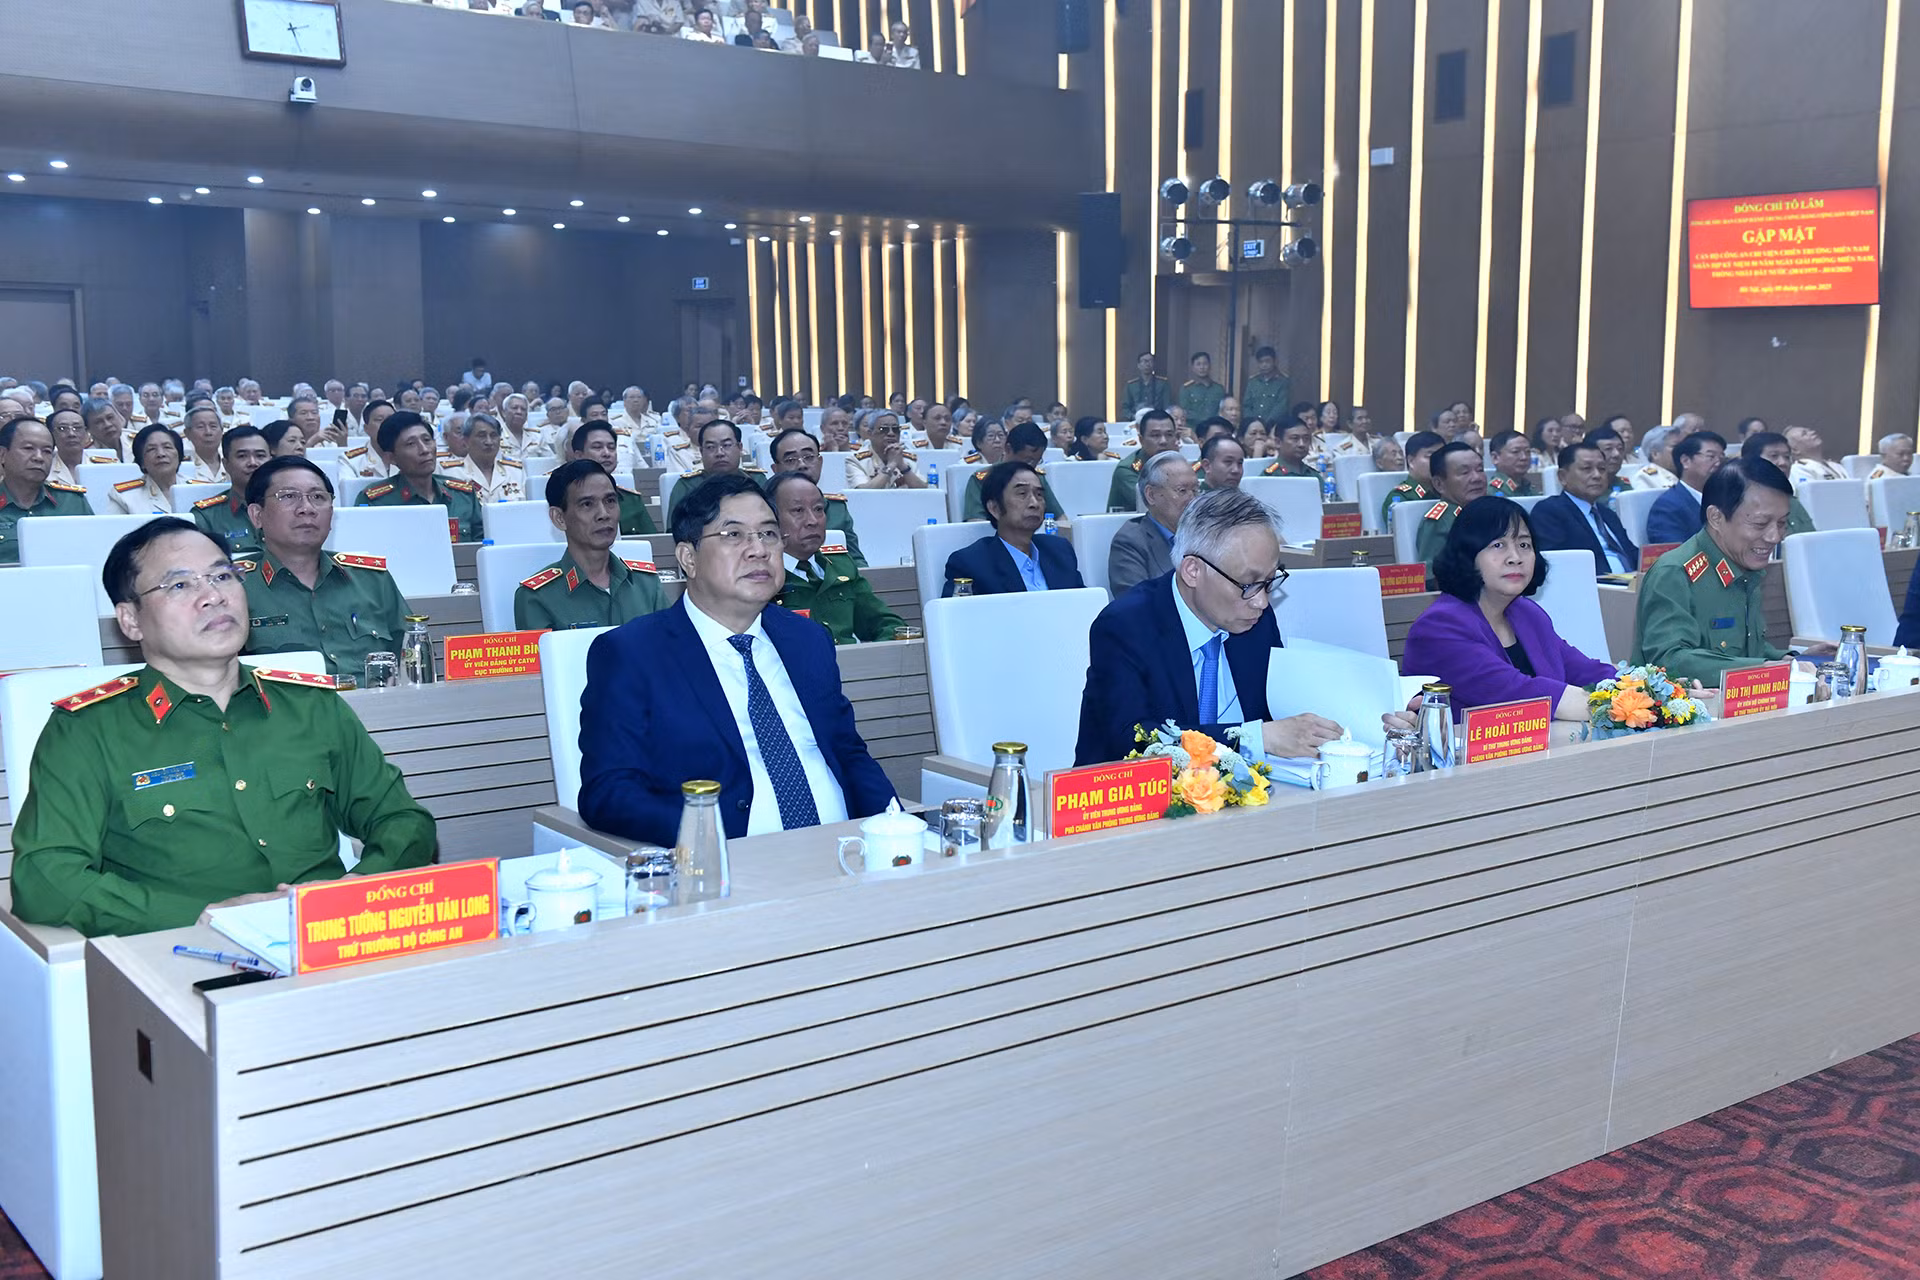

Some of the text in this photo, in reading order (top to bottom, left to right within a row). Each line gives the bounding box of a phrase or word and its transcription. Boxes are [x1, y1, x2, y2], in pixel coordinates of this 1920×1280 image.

[1742, 225, 1816, 246] GẶP MẶT
[450, 642, 540, 661] PHẠM THANH BÌN
[1727, 678, 1788, 699] BÙI THỊ MINH HOÀI
[1470, 717, 1547, 742] LÊ HOÀI TRUNG
[1094, 769, 1133, 783] ĐỒNG CHÍ
[1057, 777, 1167, 811] PHẠM GIA TÚC
[366, 879, 434, 903] ĐỒNG CHÍ
[306, 894, 490, 943] TRUNG TƯỚNG NGUYỄN VĂN LONG
[338, 926, 463, 959] THỨ TRƯỞNG BỘ CÔNG AN
